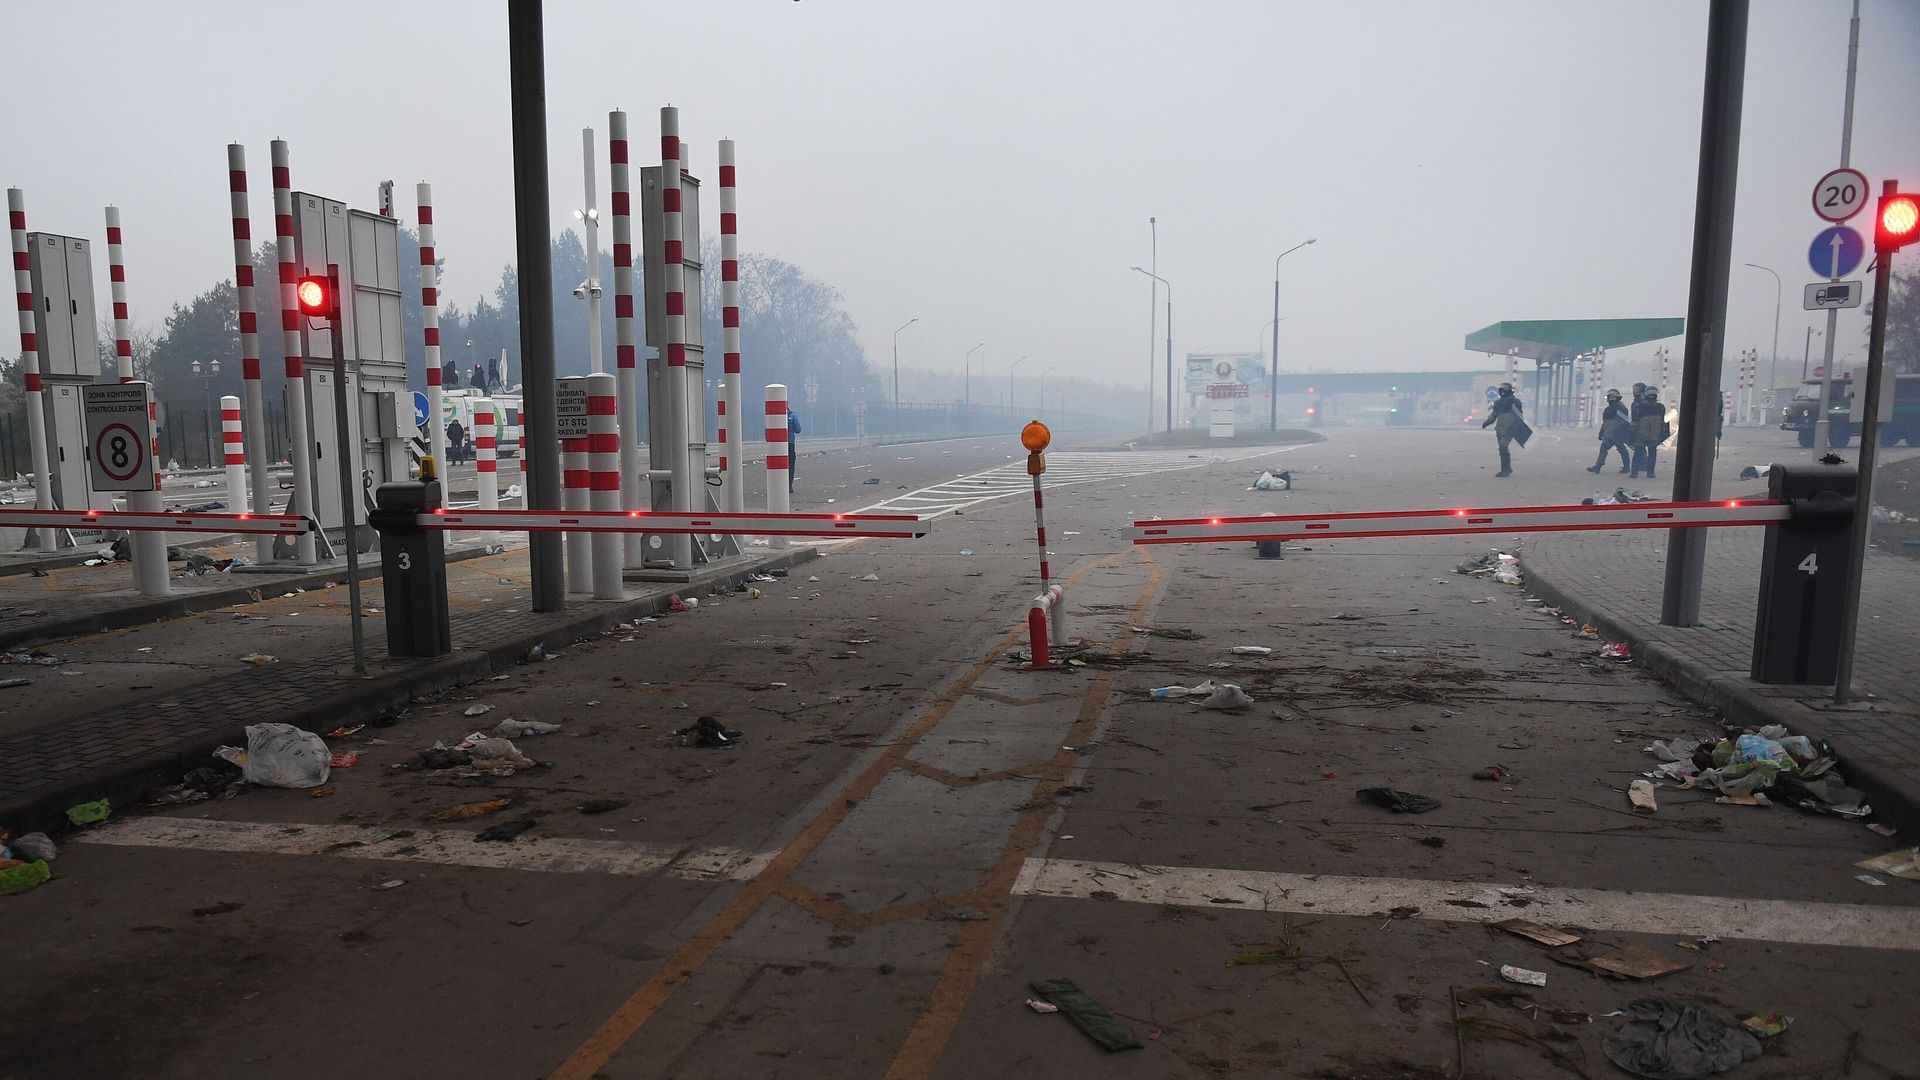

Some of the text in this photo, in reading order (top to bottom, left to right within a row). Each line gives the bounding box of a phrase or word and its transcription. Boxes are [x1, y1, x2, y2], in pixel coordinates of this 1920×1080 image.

[1824, 184, 1856, 207] 20
[107, 390, 141, 398] КОНТРОЛЯ
[87, 404, 145, 413] CONTROLLED ZONE
[111, 436, 129, 468] 8
[398, 552, 411, 570] 3
[1798, 553, 1818, 575] 4
